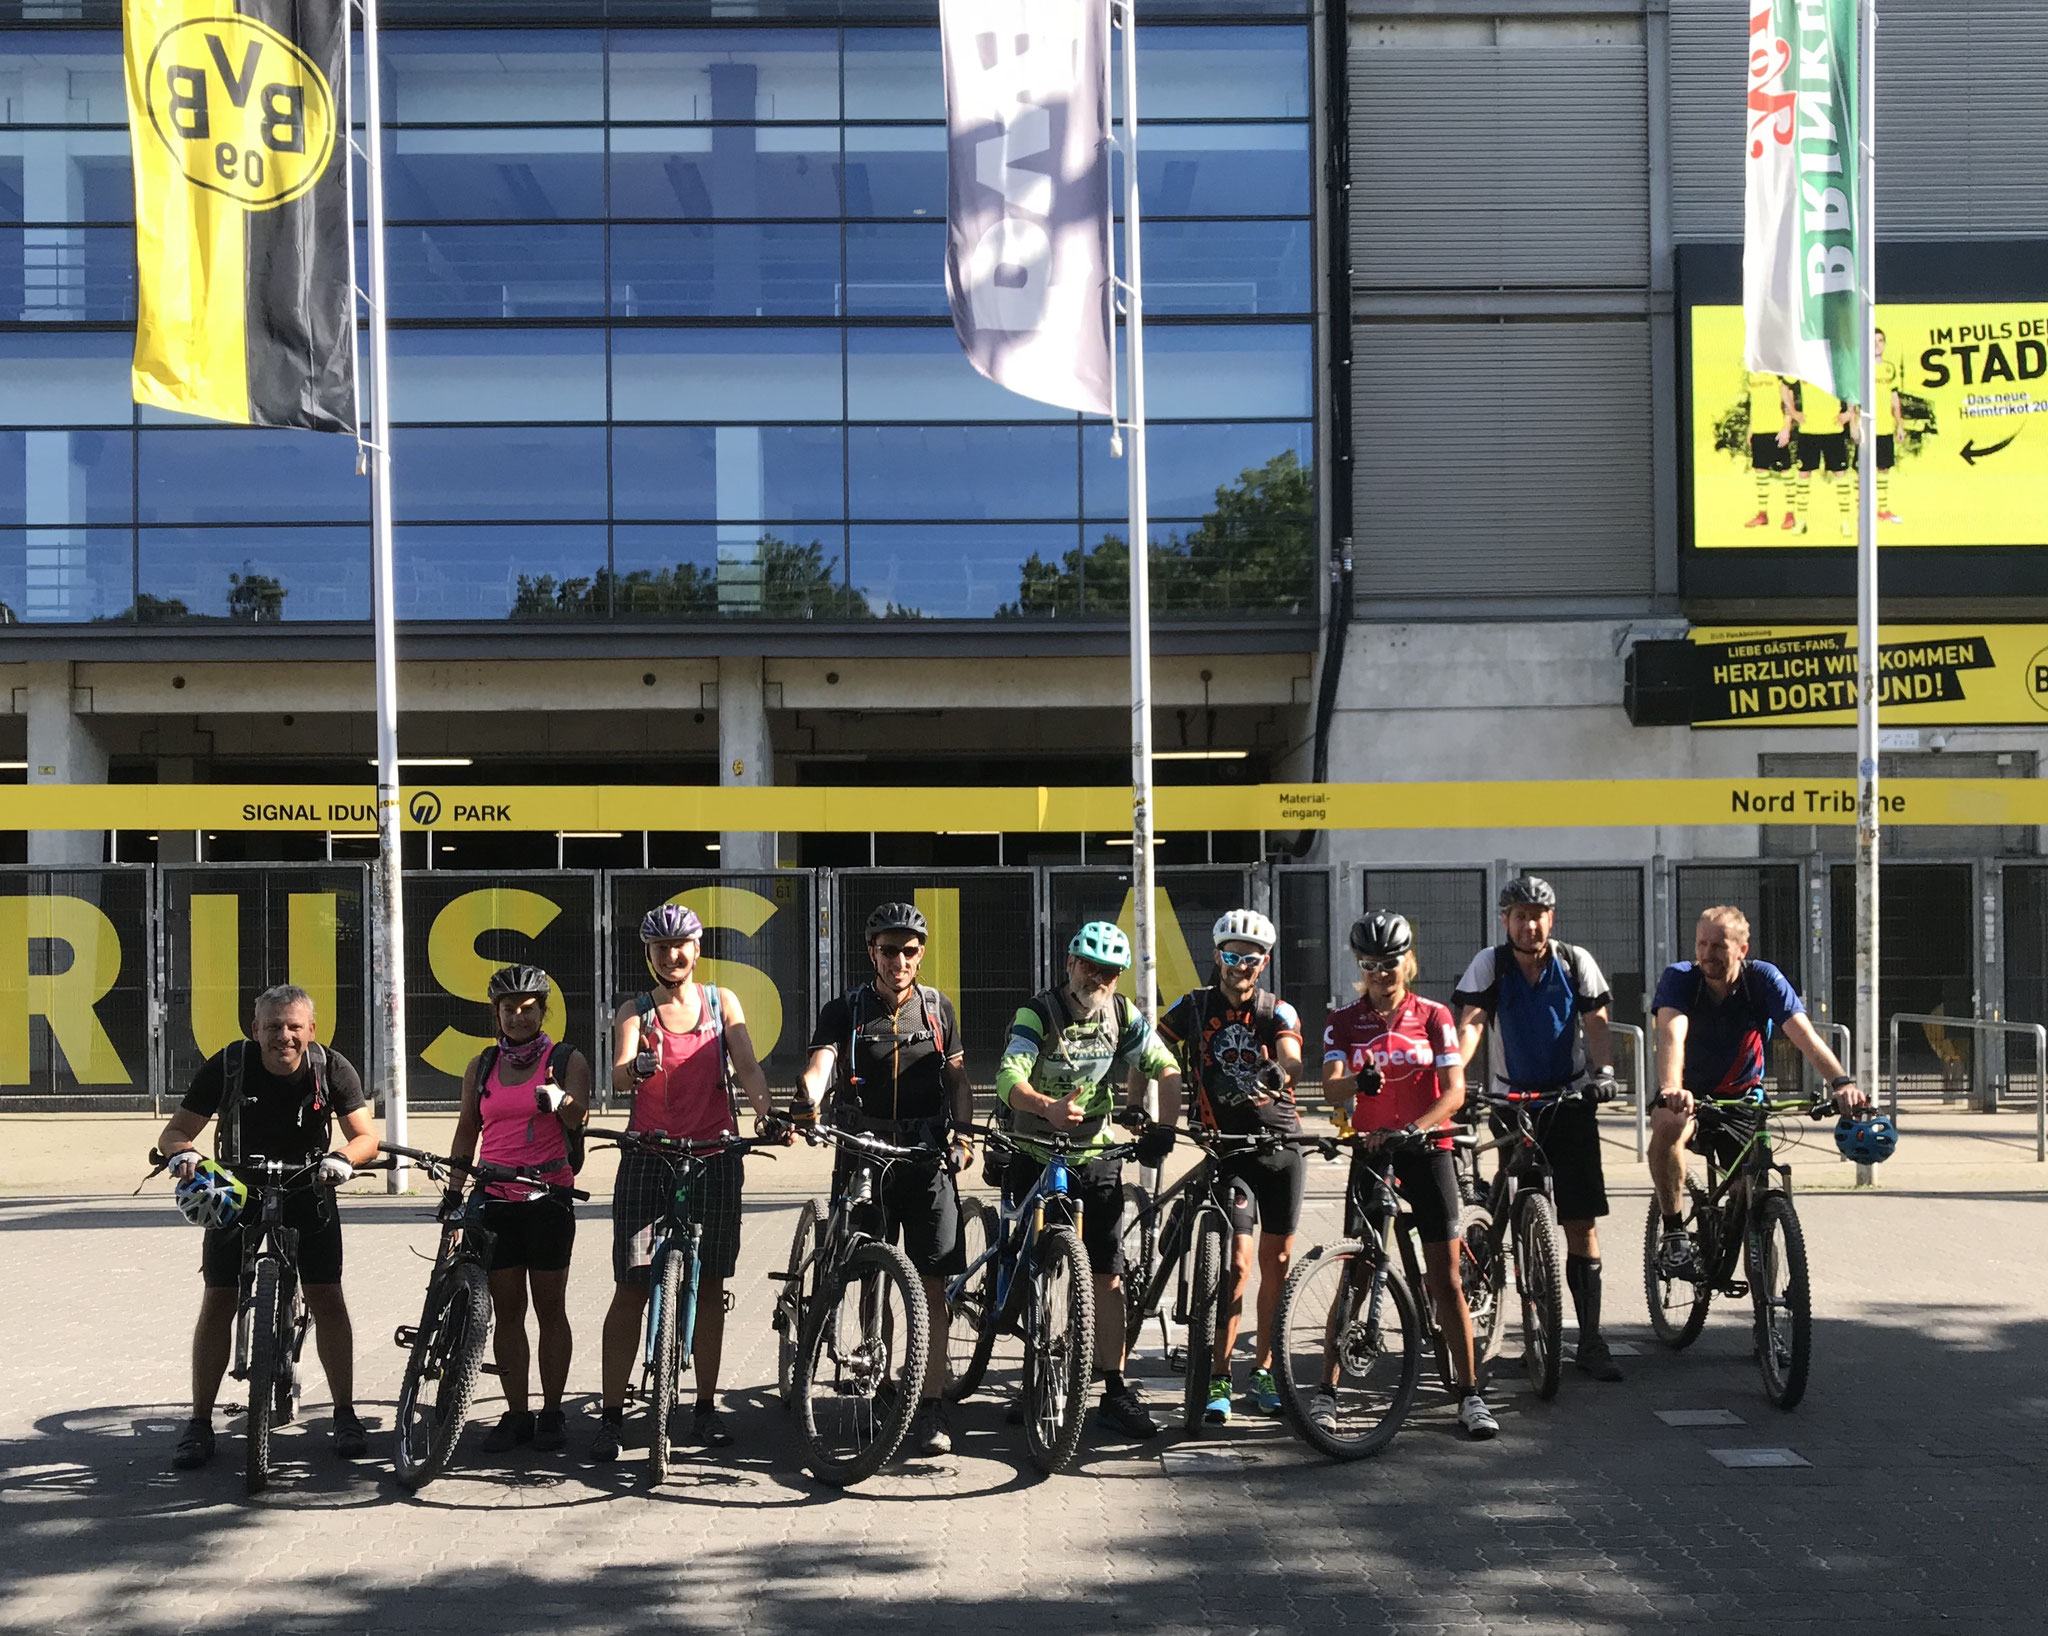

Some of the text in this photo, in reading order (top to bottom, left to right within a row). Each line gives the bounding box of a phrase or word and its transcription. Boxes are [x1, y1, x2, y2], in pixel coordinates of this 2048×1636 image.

[1930, 318, 2048, 345] IM PULS DE
[1920, 340, 2048, 388] STAD
[1966, 392, 2027, 405] Das neue
[1959, 404, 2029, 419] Heimtrikot
[1728, 643, 1762, 658] LIEBE
[1713, 644, 1974, 685] HERZLICH WILKOMMEN
[1729, 688, 1760, 714] IN
[1279, 793, 1331, 804] Material-
[1731, 789, 1906, 813] Nord Tribne
[242, 804, 511, 821] SIGNAL IDUN PARK
[1282, 807, 1326, 820] eingang
